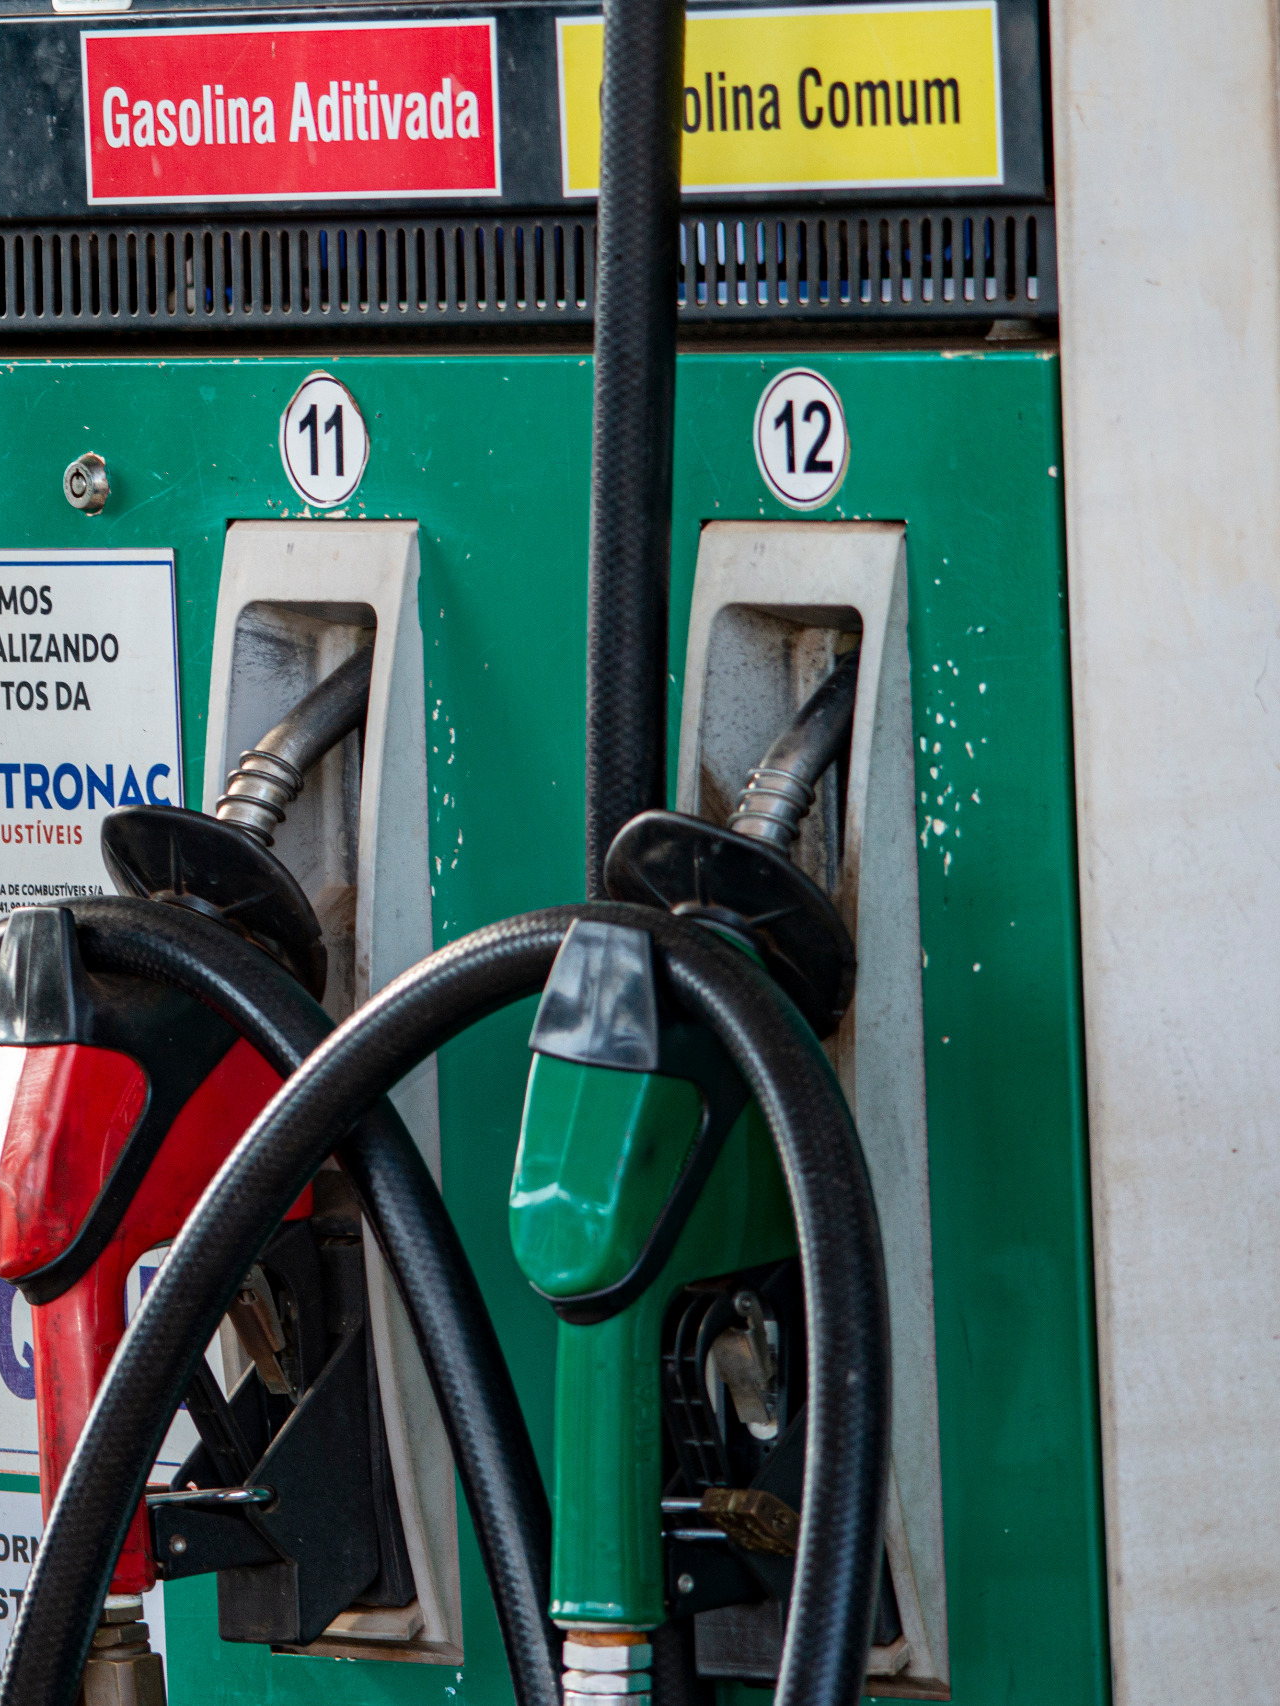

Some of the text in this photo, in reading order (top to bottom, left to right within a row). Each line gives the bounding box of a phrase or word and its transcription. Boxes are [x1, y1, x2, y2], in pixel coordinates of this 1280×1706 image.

[102, 77, 480, 149] Gasolina Aditivada
[683, 67, 961, 134] olina Comum
[298, 403, 346, 478] 11
[773, 400, 835, 475] 12
[57, 681, 92, 711] DA
[8, 883, 20, 896] DE
[21, 882, 87, 897] COMBUSTÍVEIS
[88, 884, 104, 896] S/A
